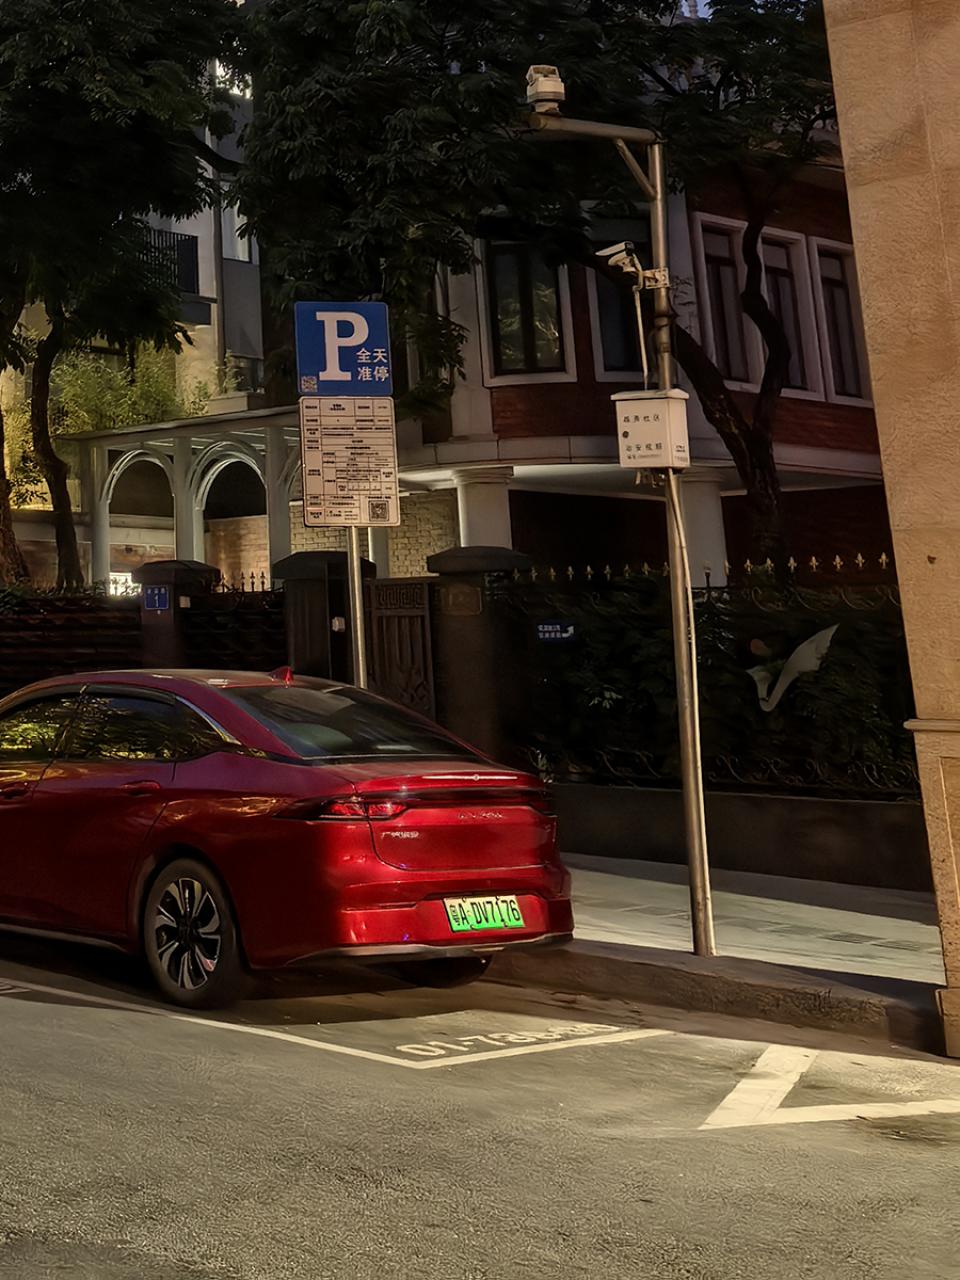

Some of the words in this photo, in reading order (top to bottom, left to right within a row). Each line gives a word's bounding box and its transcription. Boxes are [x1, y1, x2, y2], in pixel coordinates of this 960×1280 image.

[316, 311, 369, 381] P
[356, 347, 388, 364] 全天
[357, 365, 390, 382] 准停
